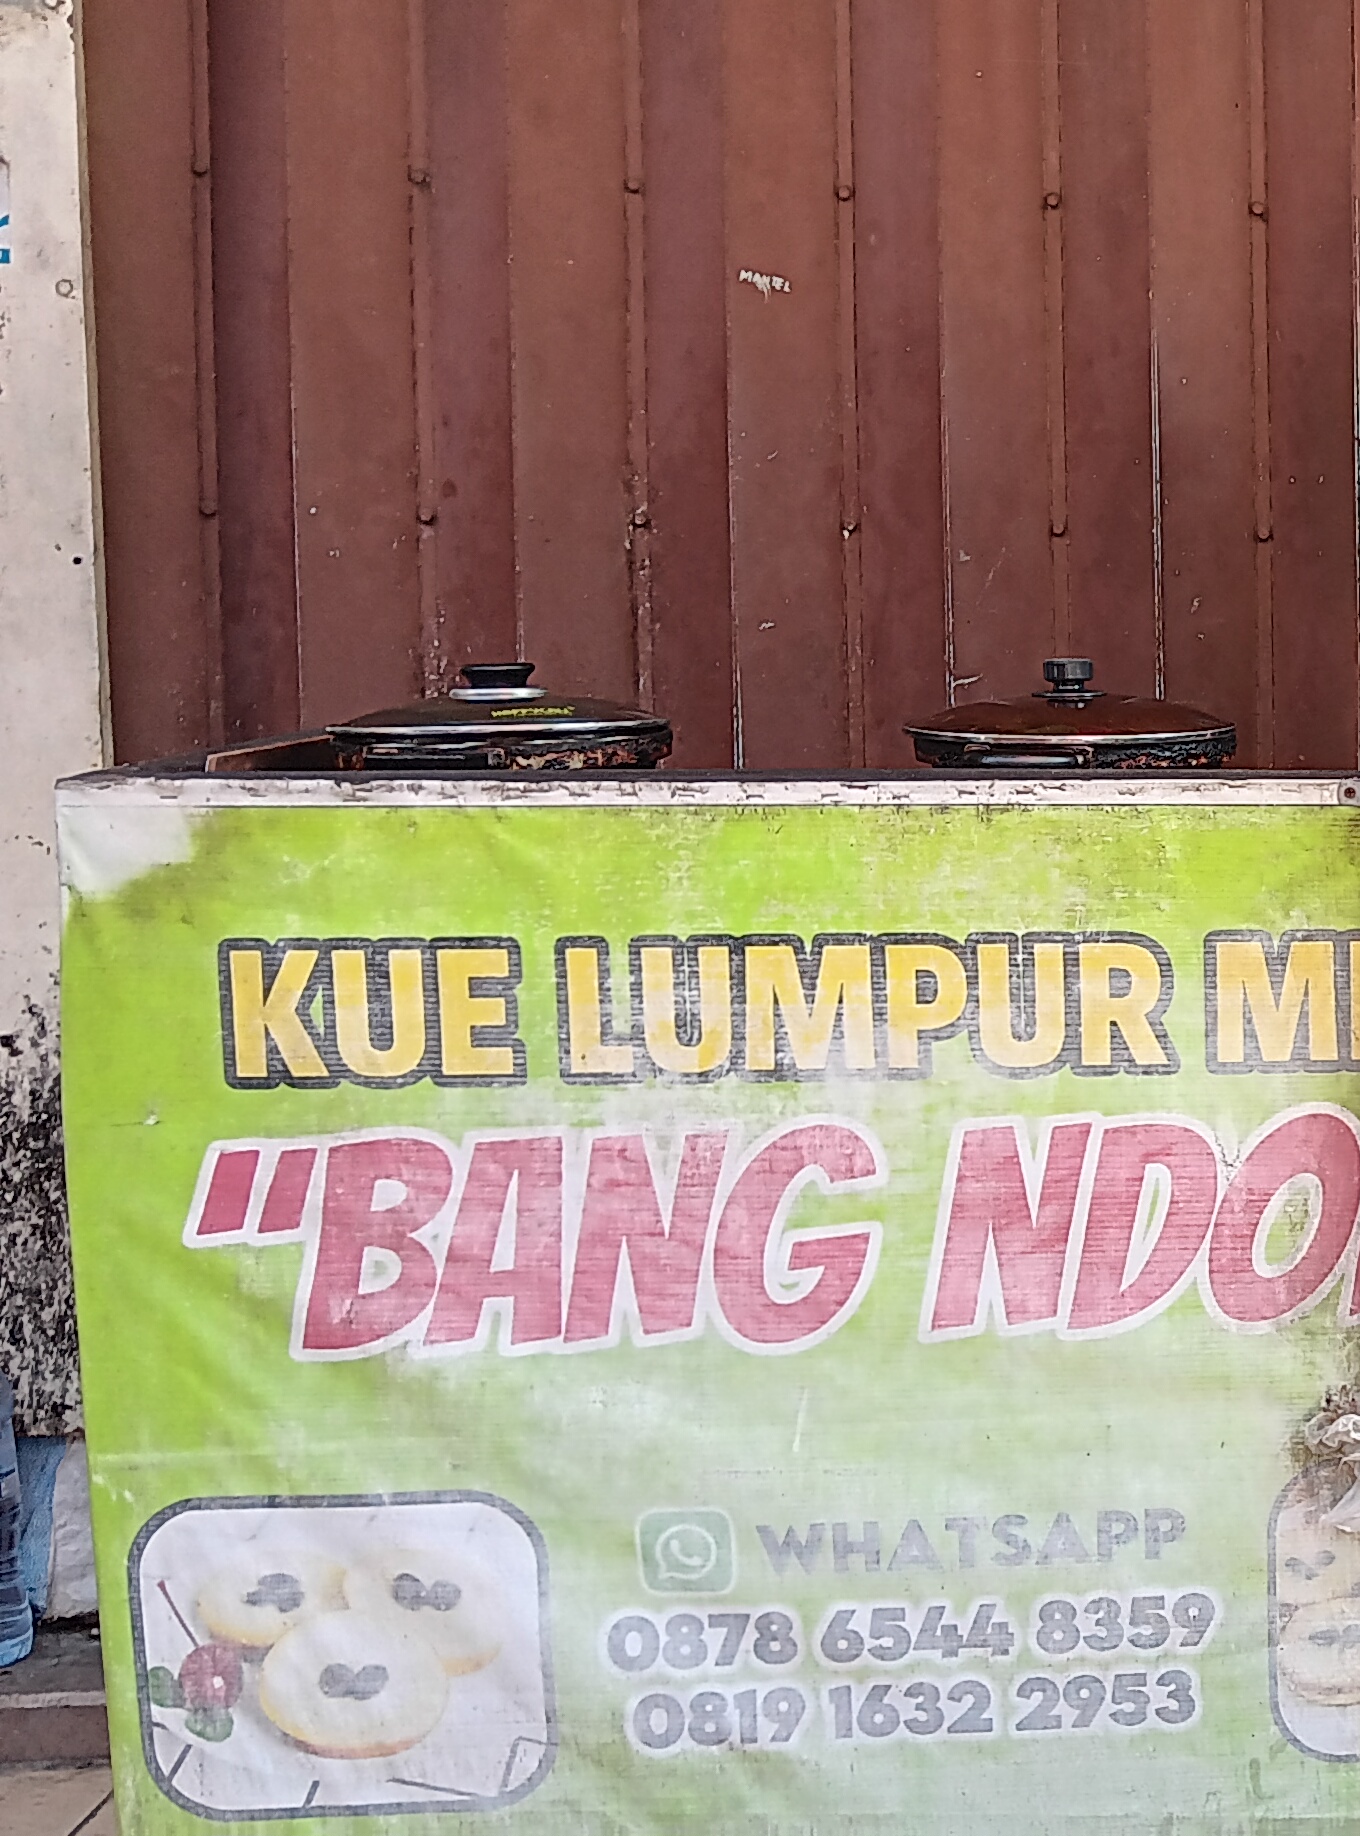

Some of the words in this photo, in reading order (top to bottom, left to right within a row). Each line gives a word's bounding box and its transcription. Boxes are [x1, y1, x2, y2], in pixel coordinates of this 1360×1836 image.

[226, 945, 515, 1082] KUE
[567, 941, 1170, 1078] LUMPUR
[196, 1120, 874, 1350] "BANG
[755, 1508, 1187, 1575] WHATSAPP
[607, 1611, 799, 1672] 0878
[820, 1603, 1015, 1662] 6544
[1035, 1593, 1216, 1655] 8359
[633, 1687, 806, 1749] 0819
[828, 1680, 994, 1739] 1632
[1015, 1669, 1197, 1732] 2953
